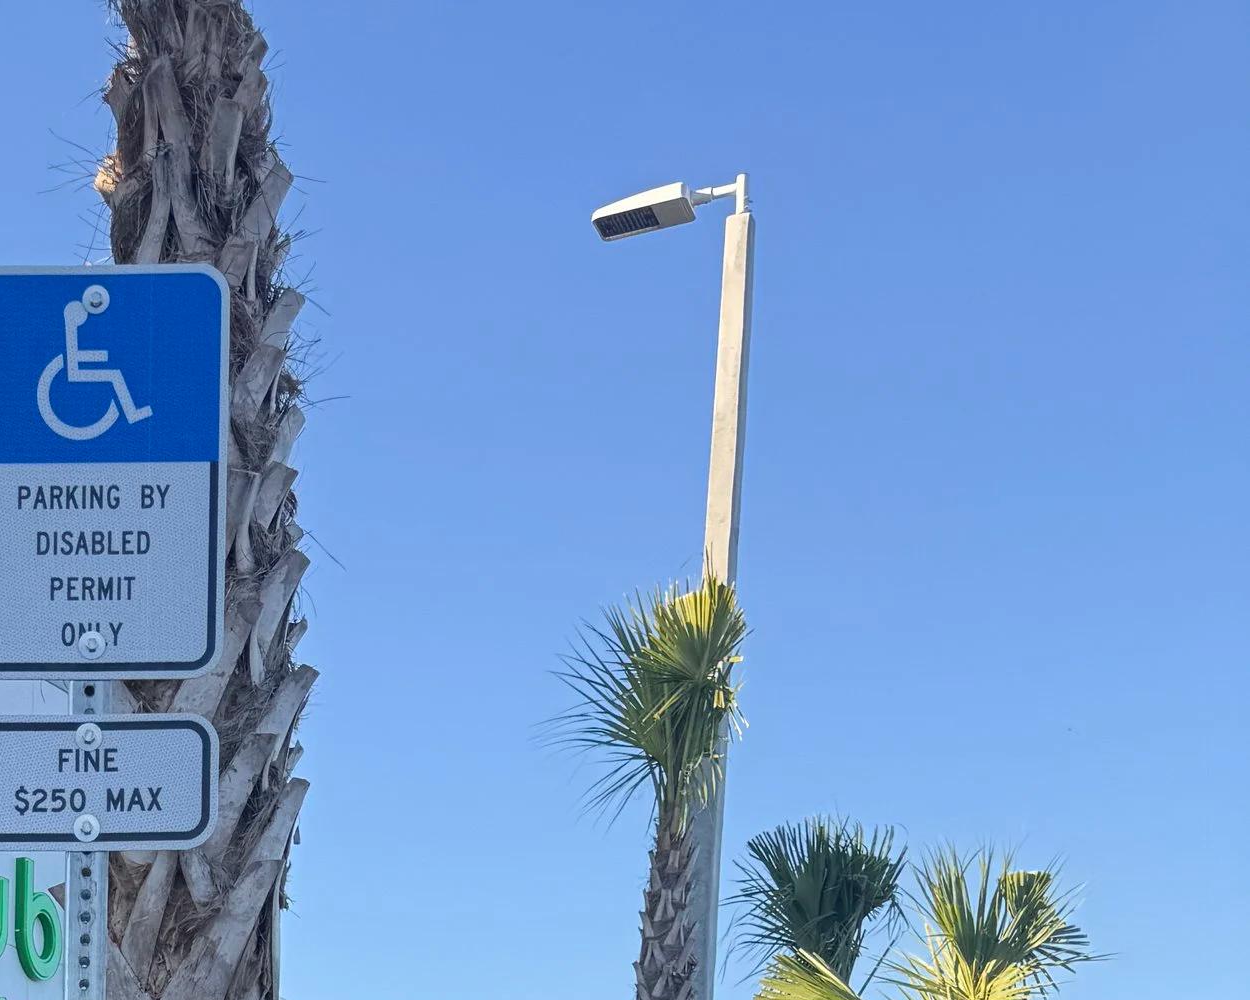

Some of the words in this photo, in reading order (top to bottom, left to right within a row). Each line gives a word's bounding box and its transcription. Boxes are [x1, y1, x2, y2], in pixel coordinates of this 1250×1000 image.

[17, 485, 121, 510] PARKING
[140, 484, 171, 509] BY
[36, 531, 151, 556] DISABLED
[50, 577, 136, 601] PERMIT
[58, 748, 119, 773] FINE
[14, 785, 87, 816] $250
[106, 787, 162, 812] MAX
